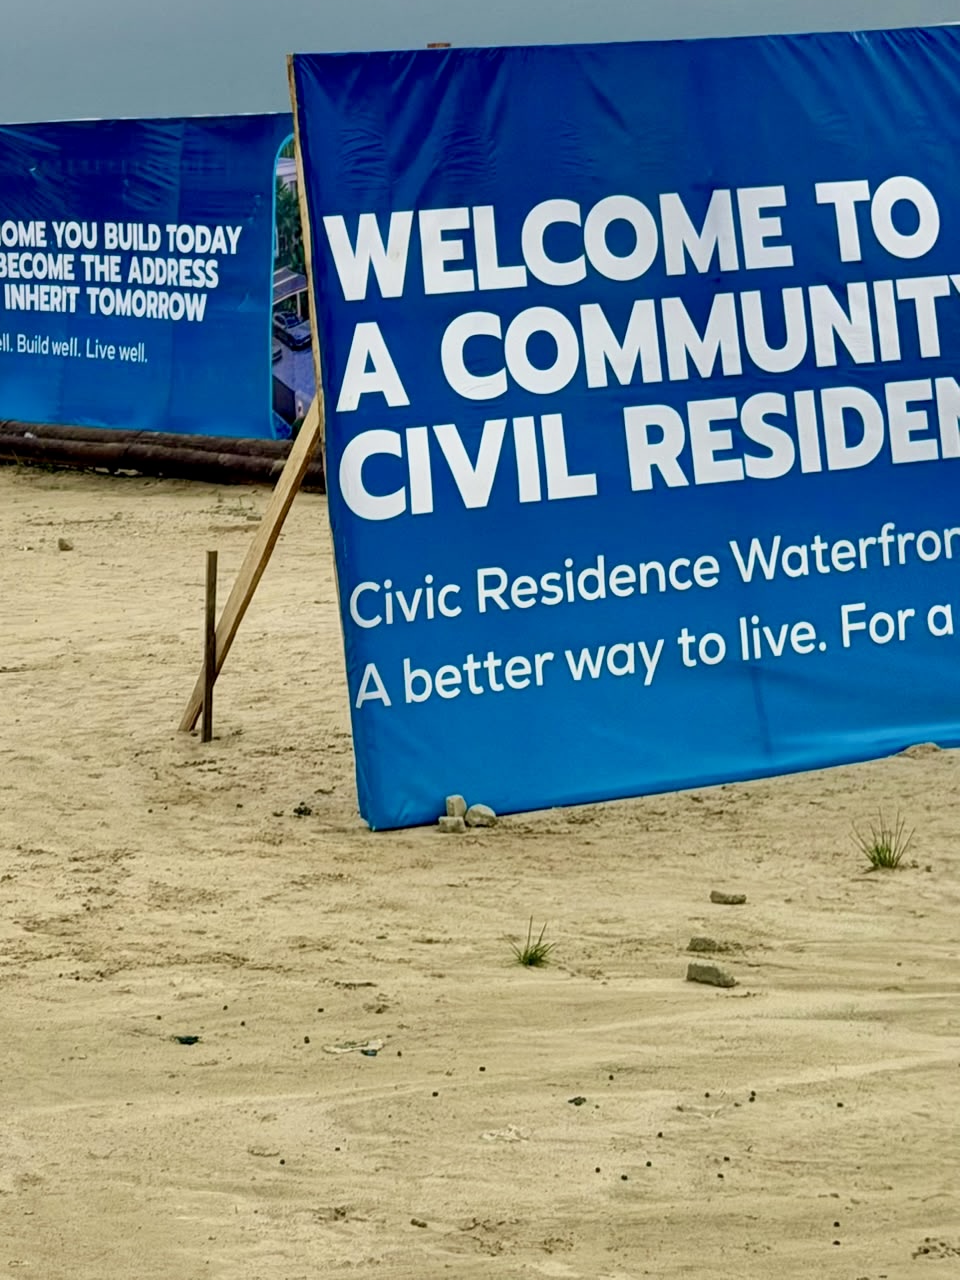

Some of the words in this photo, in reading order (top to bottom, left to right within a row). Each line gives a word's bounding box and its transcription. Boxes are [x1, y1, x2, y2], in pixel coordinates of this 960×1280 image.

[51, 220, 98, 250] YOU
[103, 221, 162, 252] BUILD
[165, 223, 243, 255] TODAY
[80, 253, 122, 283] THE
[127, 255, 220, 289] ADDRESS
[323, 184, 795, 302] WELCOME
[814, 175, 940, 263] TO
[3, 283, 81, 314] INHERIT
[85, 286, 208, 323] TOMORROW
[16, 333, 50, 355] Build
[51, 336, 82, 358] well.
[85, 337, 117, 360] Live
[118, 341, 149, 364] well.
[335, 321, 411, 413] A
[440, 274, 960, 402] COMMUNIT
[338, 412, 599, 521] CIVIL
[348, 573, 463, 629] Civic
[475, 554, 722, 614] Residence
[355, 662, 392, 709] A
[403, 650, 555, 705] better
[564, 637, 666, 687] way
[676, 626, 727, 668] to
[738, 613, 828, 662] live.
[840, 601, 917, 649] For
[926, 602, 955, 638] a
